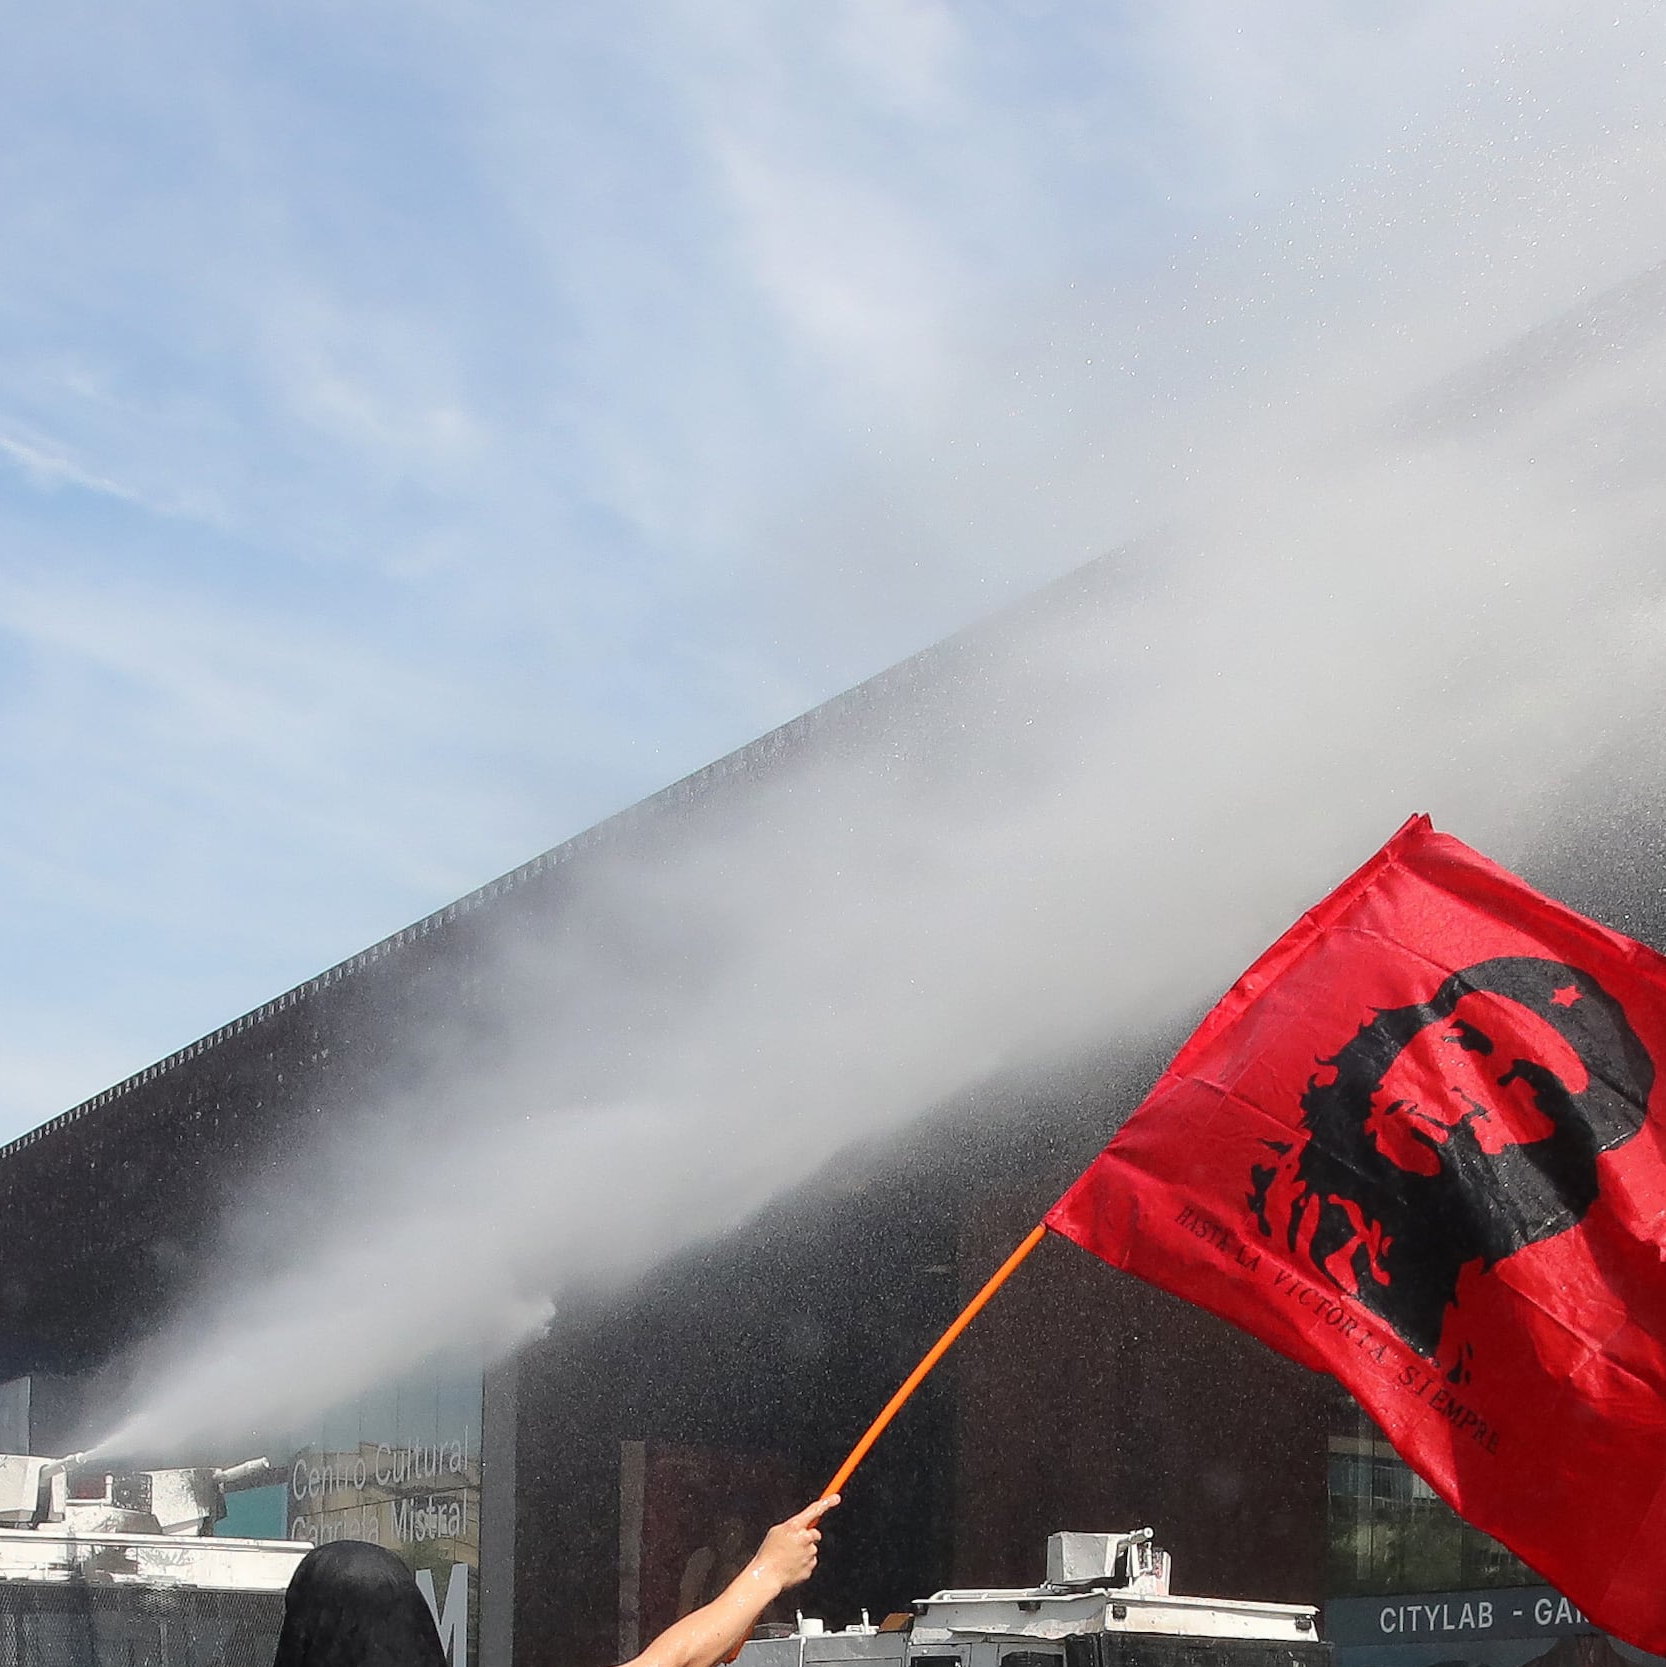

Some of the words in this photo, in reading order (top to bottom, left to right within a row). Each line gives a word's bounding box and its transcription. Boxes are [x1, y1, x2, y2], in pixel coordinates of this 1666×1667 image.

[1174, 1205, 1230, 1252] HASTA
[1235, 1251, 1262, 1274] LA
[1273, 1268, 1386, 1362] VICTORIA
[1398, 1364, 1500, 1455] SIEMPRE
[292, 1453, 367, 1501] Centro
[375, 1425, 469, 1486] Cultural
[391, 1488, 468, 1544] Mistral
[1379, 1601, 1494, 1634] CITYLAB
